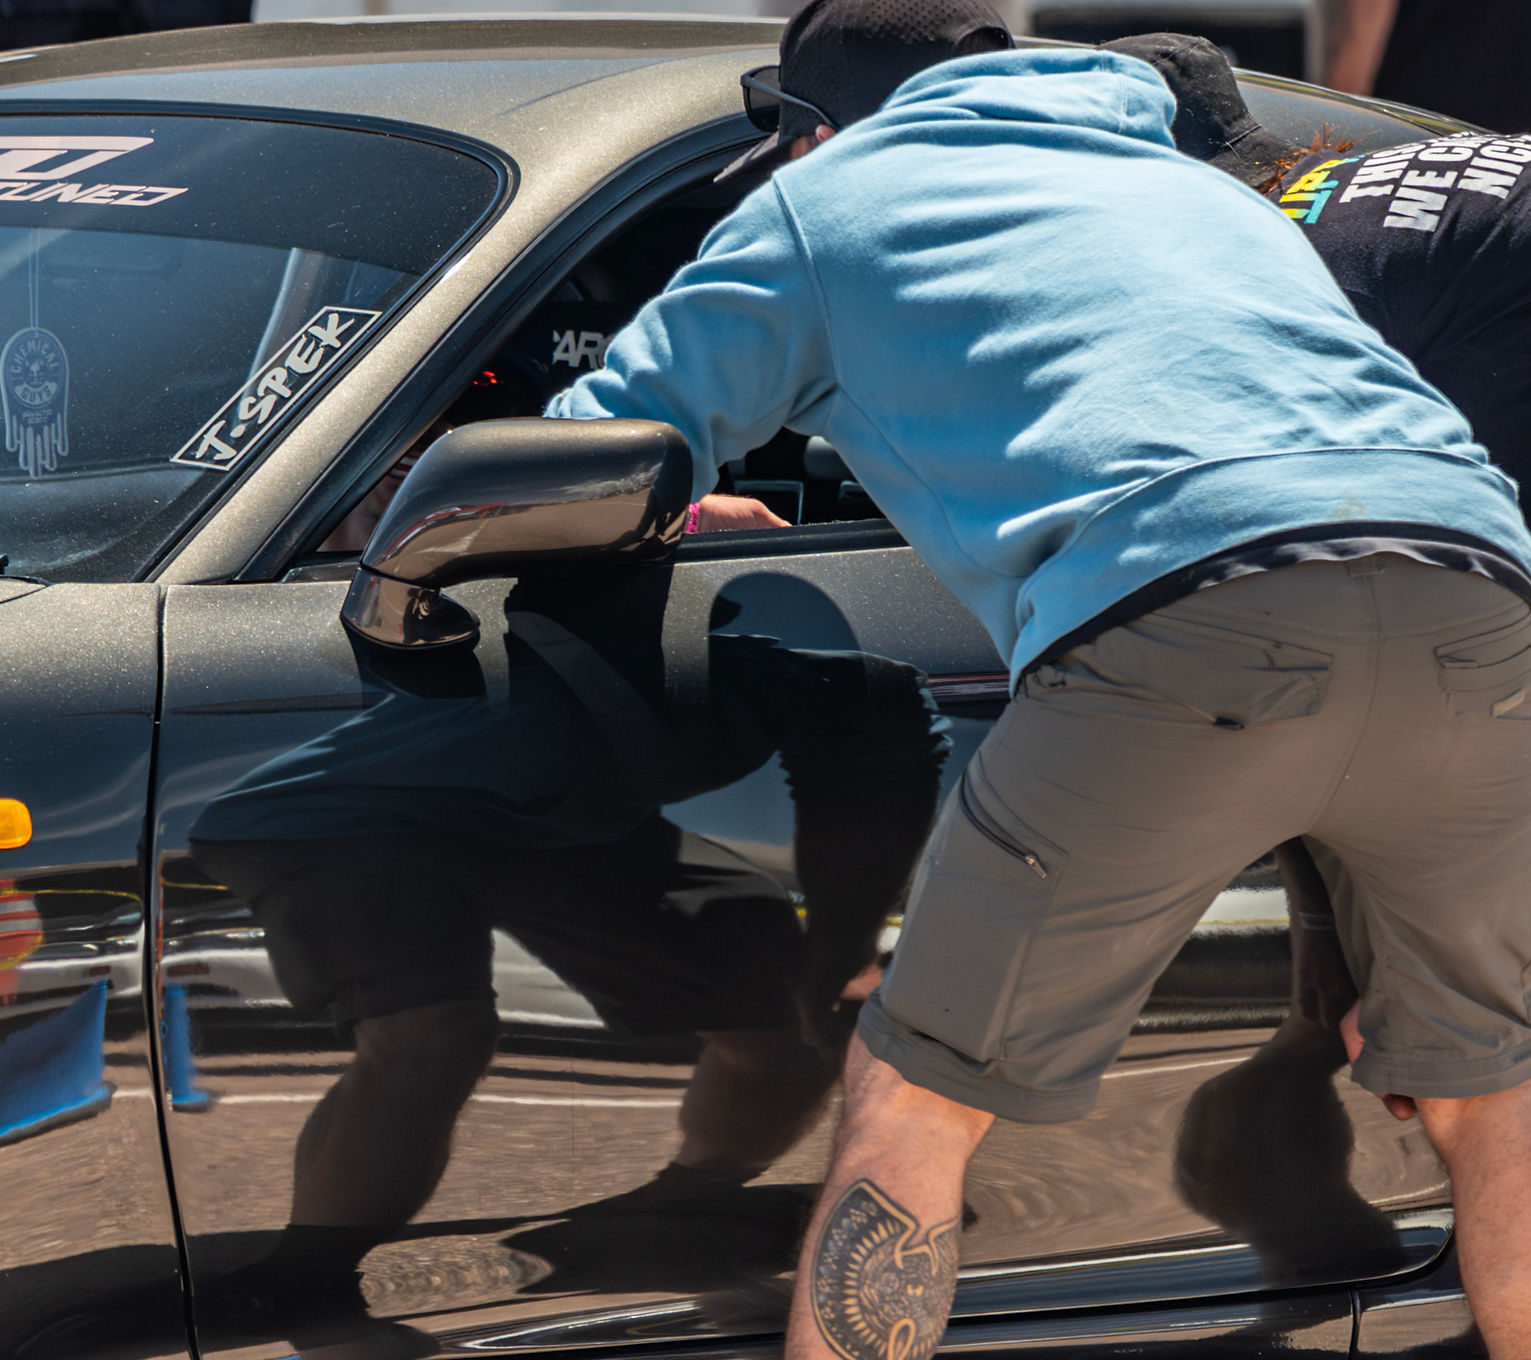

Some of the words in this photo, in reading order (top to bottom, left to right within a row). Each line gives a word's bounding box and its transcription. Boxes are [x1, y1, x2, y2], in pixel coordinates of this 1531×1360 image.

[1383, 170, 1459, 232] WE
[11, 341, 59, 374] CHEMICAL
[22, 384, 52, 402] GUYS
